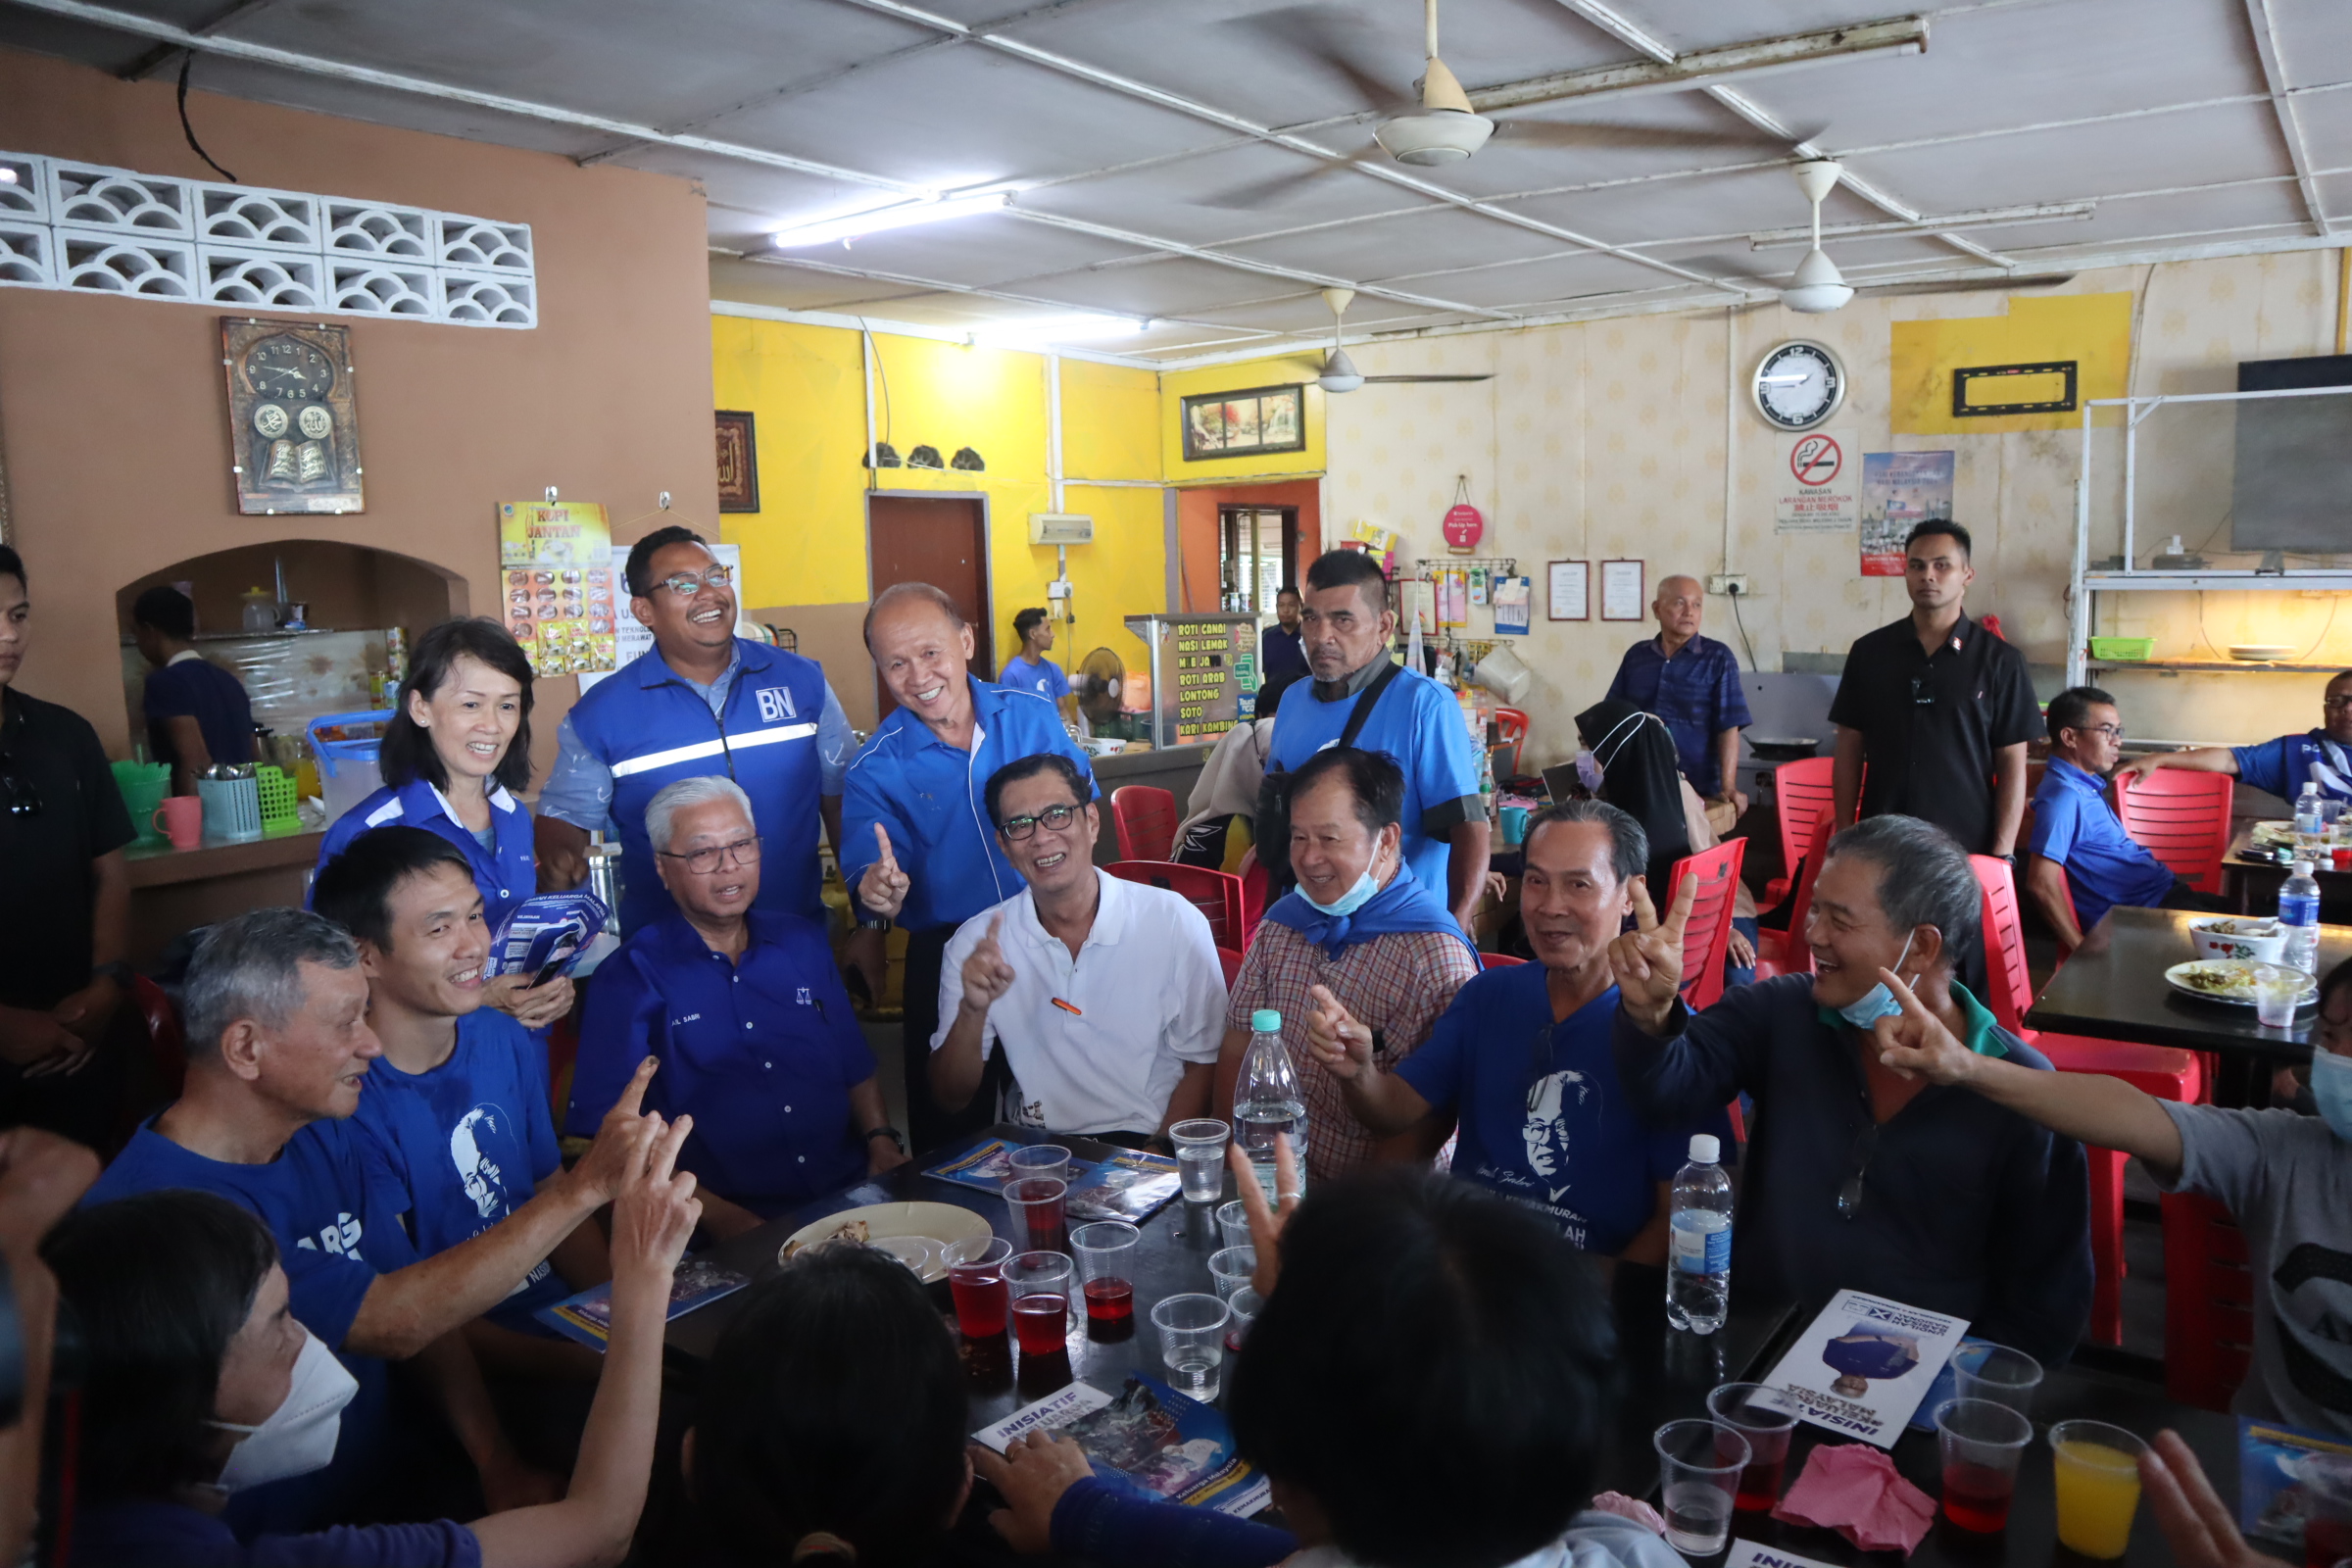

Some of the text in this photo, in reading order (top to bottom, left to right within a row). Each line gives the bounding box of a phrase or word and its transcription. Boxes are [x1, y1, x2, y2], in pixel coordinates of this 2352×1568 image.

[282, 345, 291, 354] 12
[1789, 347, 1804, 357] 12
[257, 352, 266, 361] 10
[310, 354, 316, 363] 2
[1825, 376, 1837, 388] 3
[276, 387, 283, 396] 7
[287, 389, 294, 398] 6
[1760, 383, 1771, 394] 9
[1791, 413, 1803, 425] 6
[538, 511, 569, 521] KOPI
[528, 526, 581, 538] JANTAN
[1178, 623, 1226, 636] ROTI CANAI
[1178, 639, 1228, 652] NASI LEMAK
[1179, 671, 1225, 686] ROTI ARAB
[1179, 688, 1219, 703] LONTONG
[758, 688, 795, 720] BN
[1180, 706, 1202, 718] SOTO
[1180, 723, 1200, 736] KARI
[683, 1013, 701, 1023] SABRI
[1894, 1315, 1948, 1334] BARISAN
[1897, 1312, 1950, 1330] NASIONAL
[1891, 1320, 1945, 1337] UNDILAH
[1788, 1383, 1877, 1417] MALAYSIA
[996, 1392, 1077, 1439] INISIATIF
[1176, 1478, 1207, 1500] Keluarga
[1207, 1457, 1237, 1481] Malaysia
